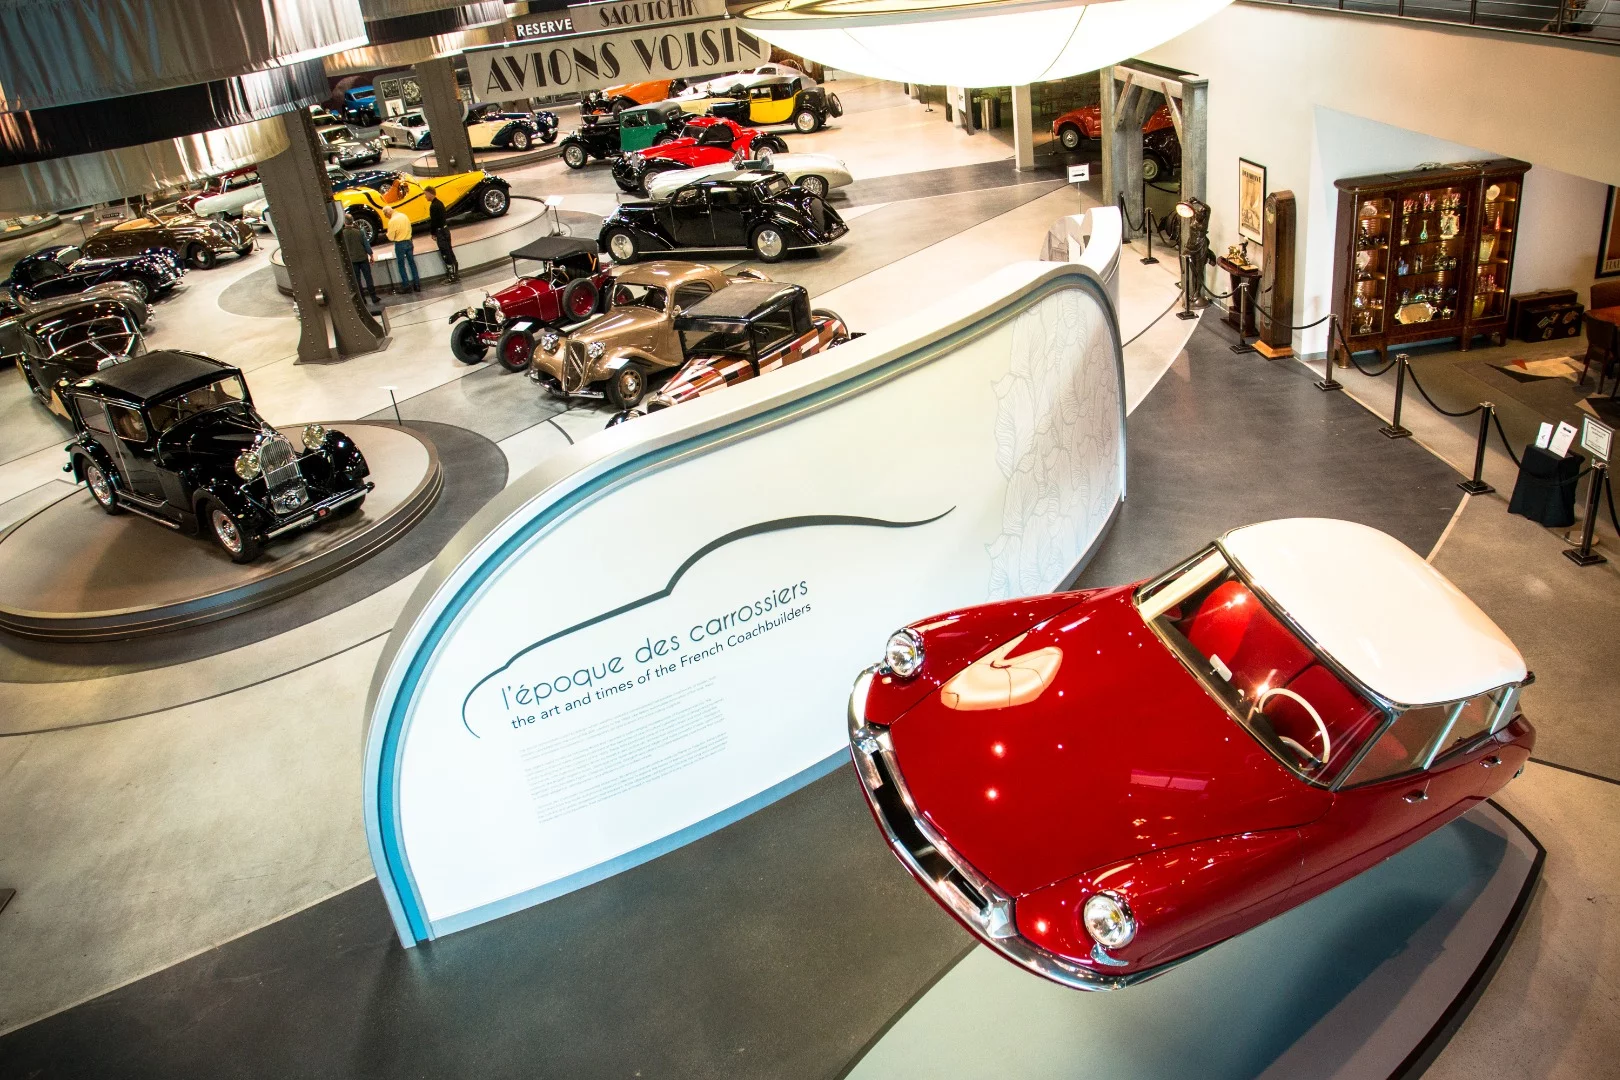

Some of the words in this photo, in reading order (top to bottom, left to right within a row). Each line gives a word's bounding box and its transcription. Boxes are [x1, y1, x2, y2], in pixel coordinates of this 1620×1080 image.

[516, 18, 573, 37] RESERVE
[599, 0, 699, 28] SAOUTCHIK
[486, 41, 621, 95] AVIONS
[630, 25, 762, 75] VOISIN
[501, 656, 624, 711] l'époque
[635, 637, 680, 664] des
[689, 580, 809, 642] carrossiers
[511, 715, 536, 729] the
[540, 705, 561, 720] art
[564, 692, 592, 712] and
[595, 680, 634, 700] times
[637, 669, 651, 685] of
[654, 664, 677, 678] the
[680, 641, 724, 668] French
[726, 603, 812, 648] Coachbuilders
